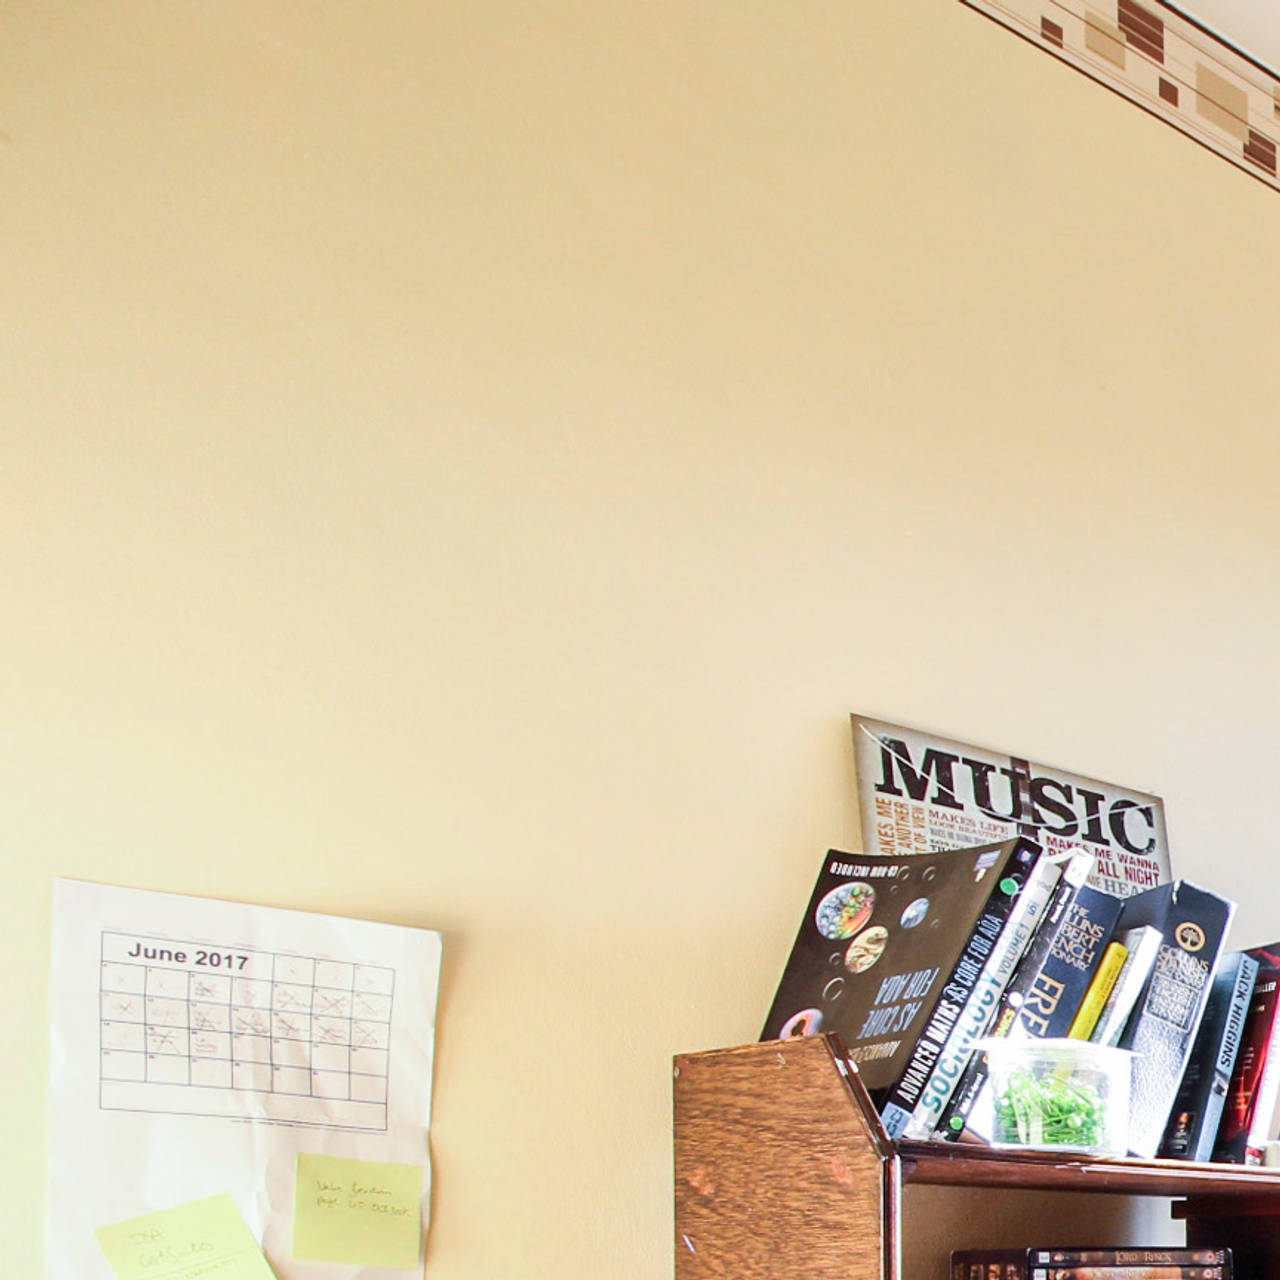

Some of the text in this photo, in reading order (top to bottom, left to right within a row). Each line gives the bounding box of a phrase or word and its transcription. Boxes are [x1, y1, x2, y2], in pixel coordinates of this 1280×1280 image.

[874, 735, 1156, 856] MUSIC
[878, 822, 895, 855] AKES
[929, 809, 1009, 836] MAKES LIFE
[1095, 847, 1113, 860] ME
[1117, 853, 1160, 872] WANNA
[1097, 860, 1160, 887] ALL NIGHT
[1061, 923, 1100, 950] BERT
[1066, 911, 1105, 939] LLINS
[128, 942, 250, 971] June 2017
[998, 930, 1027, 975] VOLUME
[873, 967, 941, 1006] FOR AQA
[1234, 958, 1255, 1001] JACK
[855, 1001, 923, 1040] AS CORE
[896, 913, 1004, 1105] ADVANCED MATHS AS CORE FOR AQA
[1219, 1001, 1245, 1069] HIGGINS
